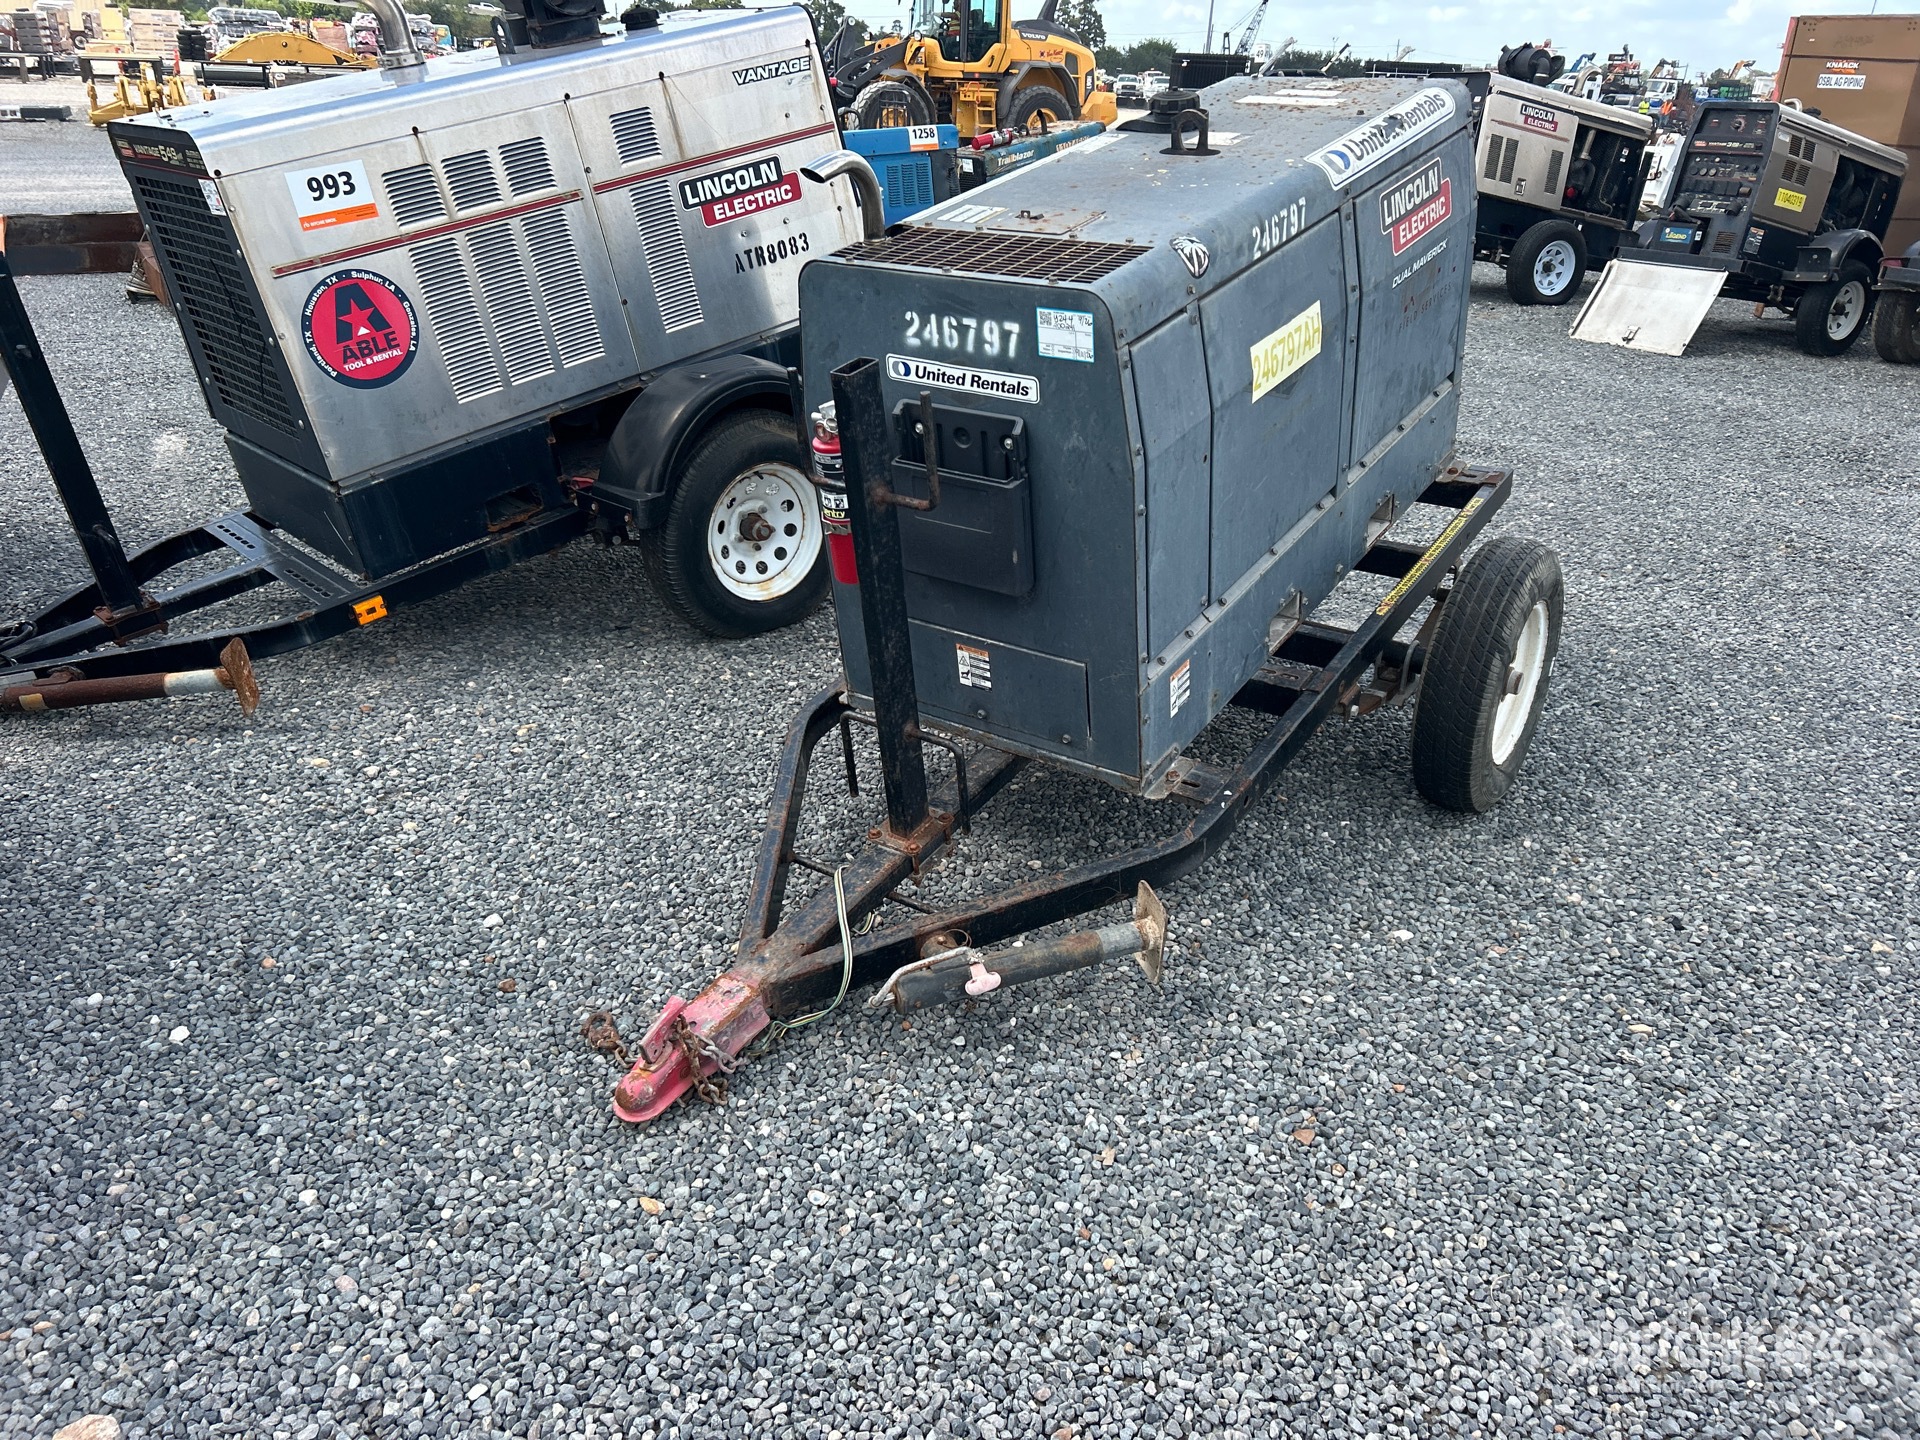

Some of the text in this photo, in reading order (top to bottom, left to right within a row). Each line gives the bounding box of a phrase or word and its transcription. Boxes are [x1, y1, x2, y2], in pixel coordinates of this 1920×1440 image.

[1021, 32, 1046, 40] VOLVO
[732, 57, 811, 85] VANTAGE
[1826, 61, 1860, 69] KNAACK
[1522, 105, 1554, 121] LINCOLN
[1527, 118, 1555, 131] ELECTRIC
[912, 127, 935, 139] 1258
[306, 171, 357, 202] 993
[684, 161, 778, 206] LINCOLN
[1383, 166, 1439, 227] LINCOLN
[713, 184, 793, 221] ELECTRIC
[1252, 196, 1306, 260] 246797
[1399, 195, 1446, 245] ELECTRIC
[735, 232, 810, 274] ATR8083
[1392, 238, 1449, 289] DUAL MAVERICK
[325, 275, 339, 287] TX
[351, 271, 384, 285] Sulphur,
[385, 280, 396, 292] LA
[304, 284, 329, 316] Houston,
[304, 330, 314, 345] TX
[343, 330, 401, 364] ABLE
[408, 340, 418, 351] LA
[904, 310, 1020, 359] 246797
[309, 343, 338, 378] Portland,
[343, 348, 404, 372] TOOL & RENTAL
[1253, 312, 1321, 392] 246797AH
[914, 364, 1029, 397] United Rentals
